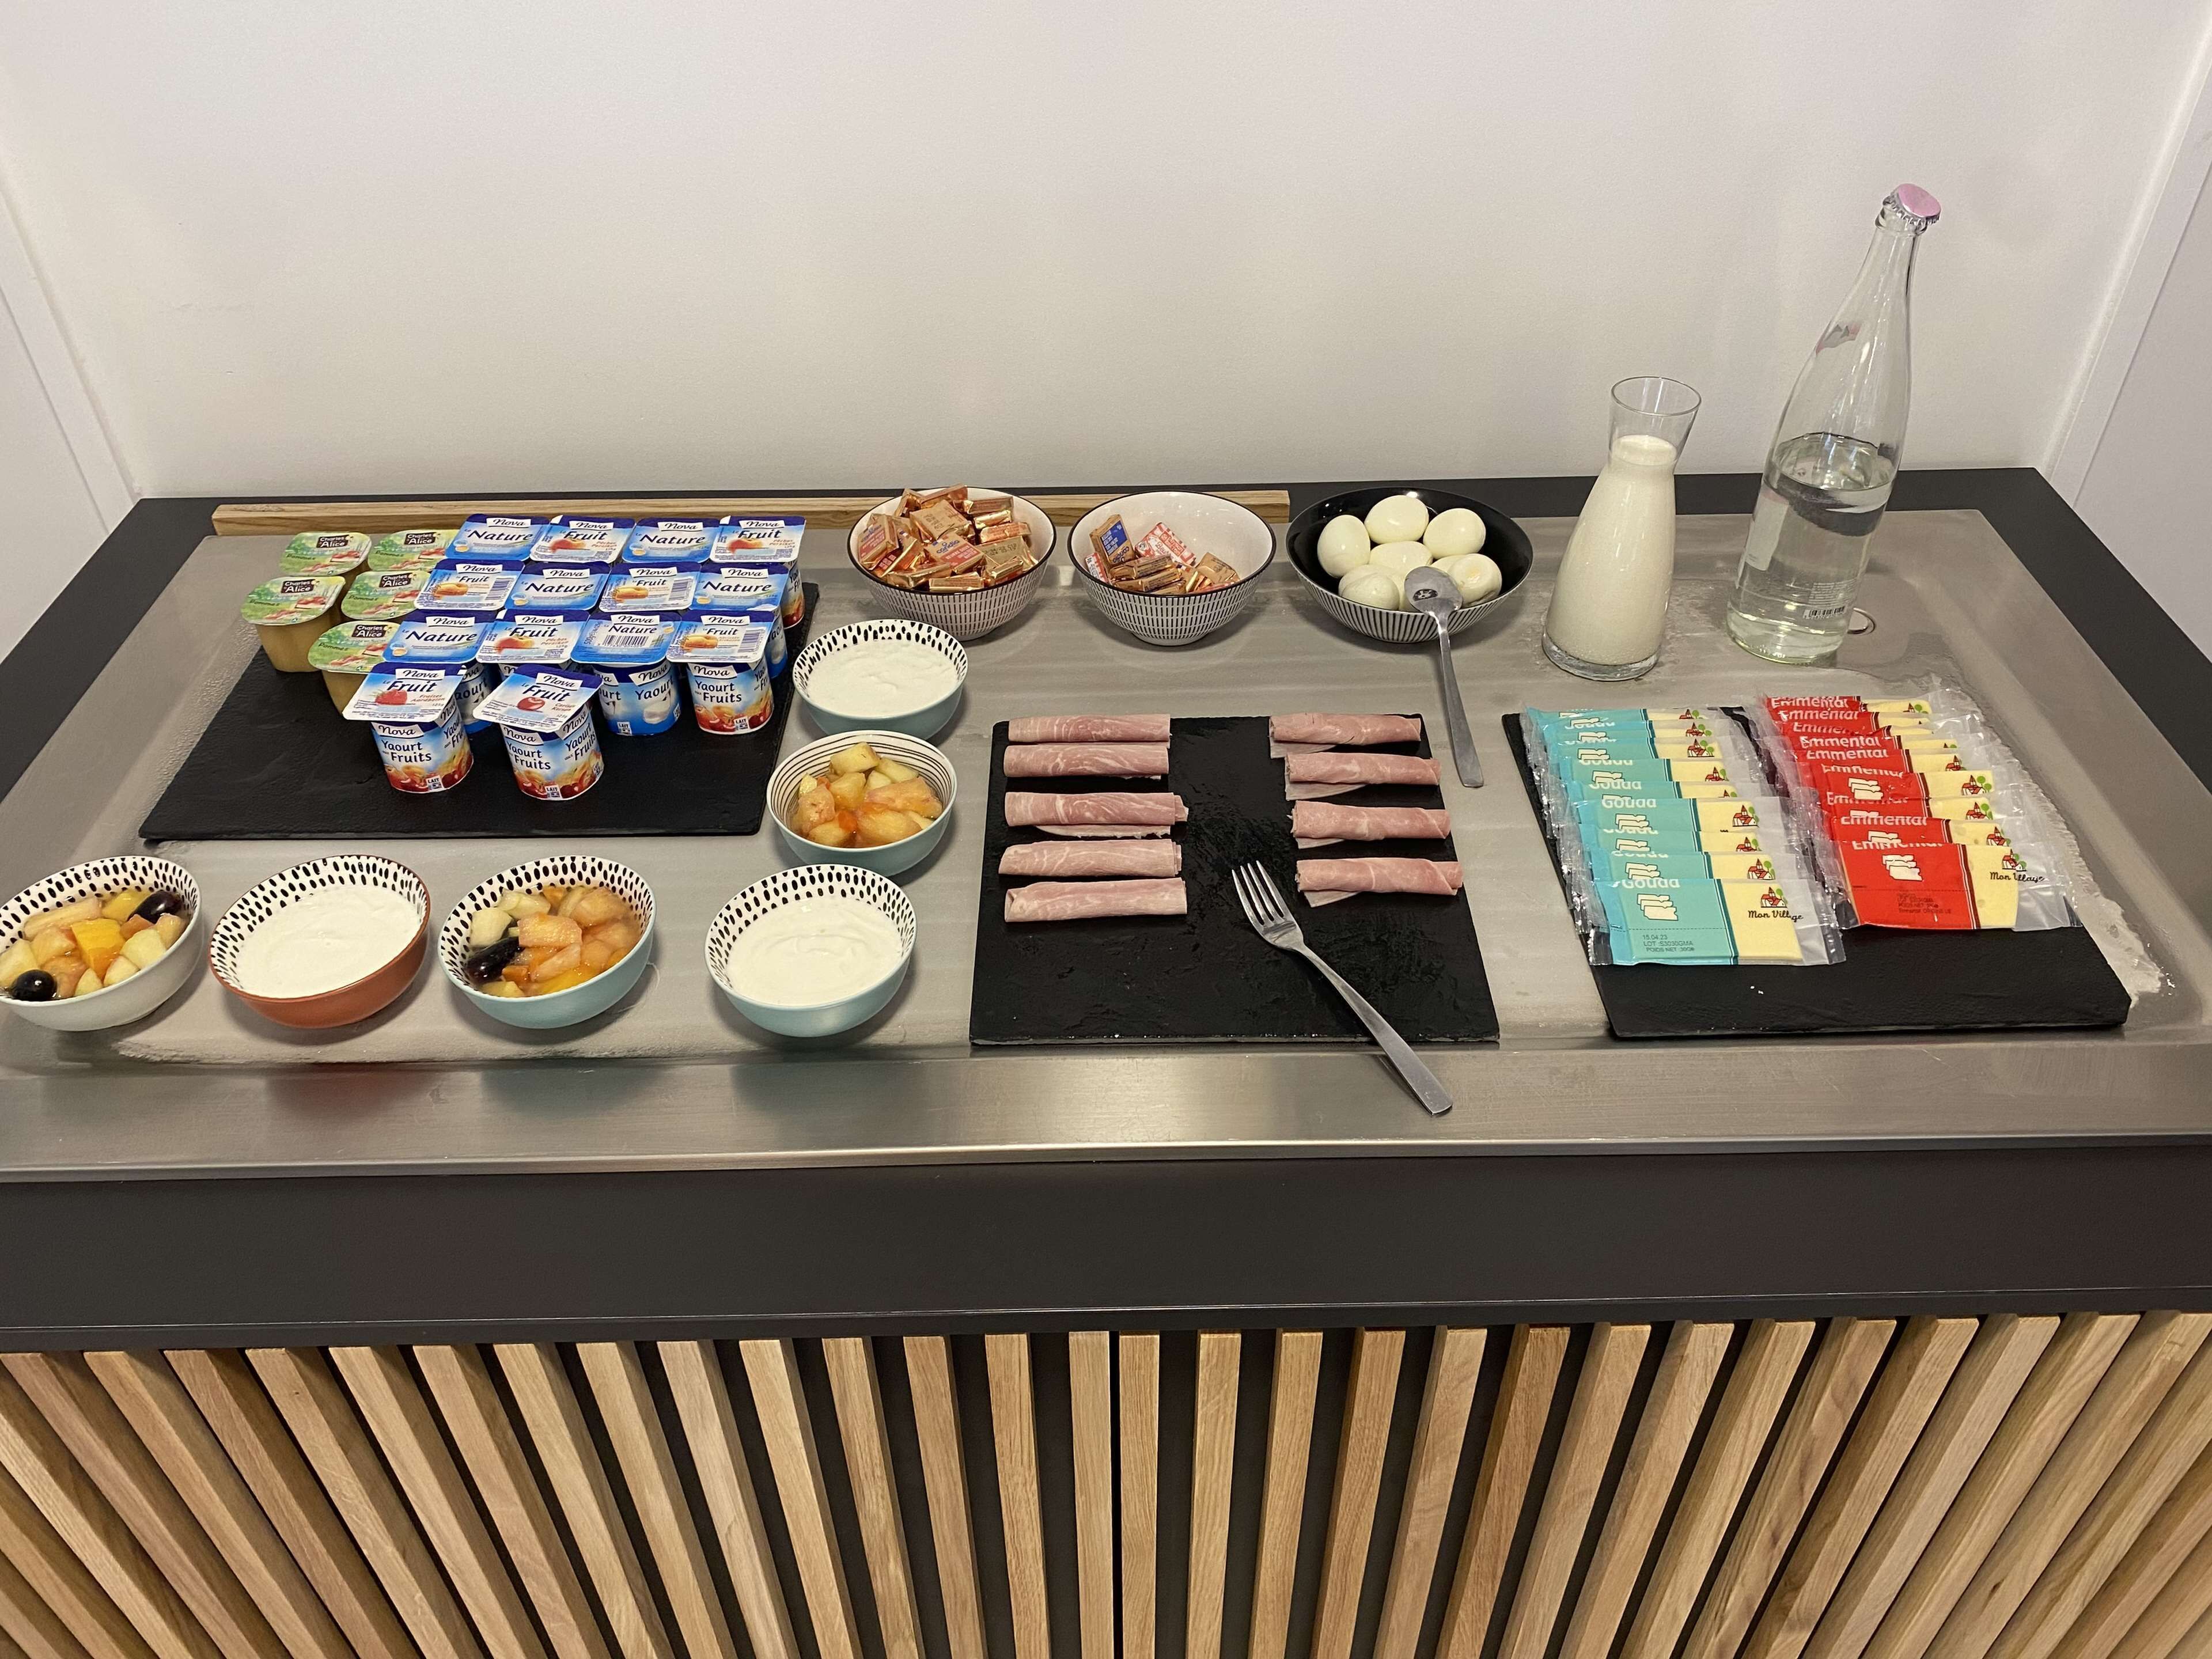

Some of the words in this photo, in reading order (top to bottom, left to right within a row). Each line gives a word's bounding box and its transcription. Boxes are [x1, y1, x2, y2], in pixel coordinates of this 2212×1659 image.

[468, 530, 533, 541] Nature
[564, 531, 607, 540] Fruit
[639, 535, 706, 544] Nature
[738, 529, 782, 539] Fruit
[525, 583, 594, 592] Nature
[703, 581, 772, 592] Nature
[433, 618, 469, 626] Nova
[509, 627, 558, 637] Fruit
[608, 625, 657, 634] Nature
[406, 631, 477, 642] Nature
[403, 670, 439, 678] Nova
[463, 666, 479, 680] ova
[694, 665, 730, 676] Nova
[387, 681, 437, 692] Fruit
[543, 675, 575, 688] Nova
[695, 680, 735, 692] Yaourt
[454, 677, 488, 700] aourt
[522, 685, 570, 702] Fruit
[635, 676, 673, 700] Yaourt
[703, 692, 742, 703] Fruits
[378, 725, 415, 736] Nova
[504, 727, 536, 743] Nova
[566, 723, 592, 751] Yaourt
[381, 740, 423, 751] Yaourt
[507, 741, 543, 759] Yaourt
[574, 732, 596, 761] Fruits
[391, 752, 432, 763] Fruits
[514, 755, 551, 770] Fruits
[1990, 872, 2012, 880] Mon
[1748, 910, 1770, 918] Mon
[1771, 910, 1804, 922] Villge
